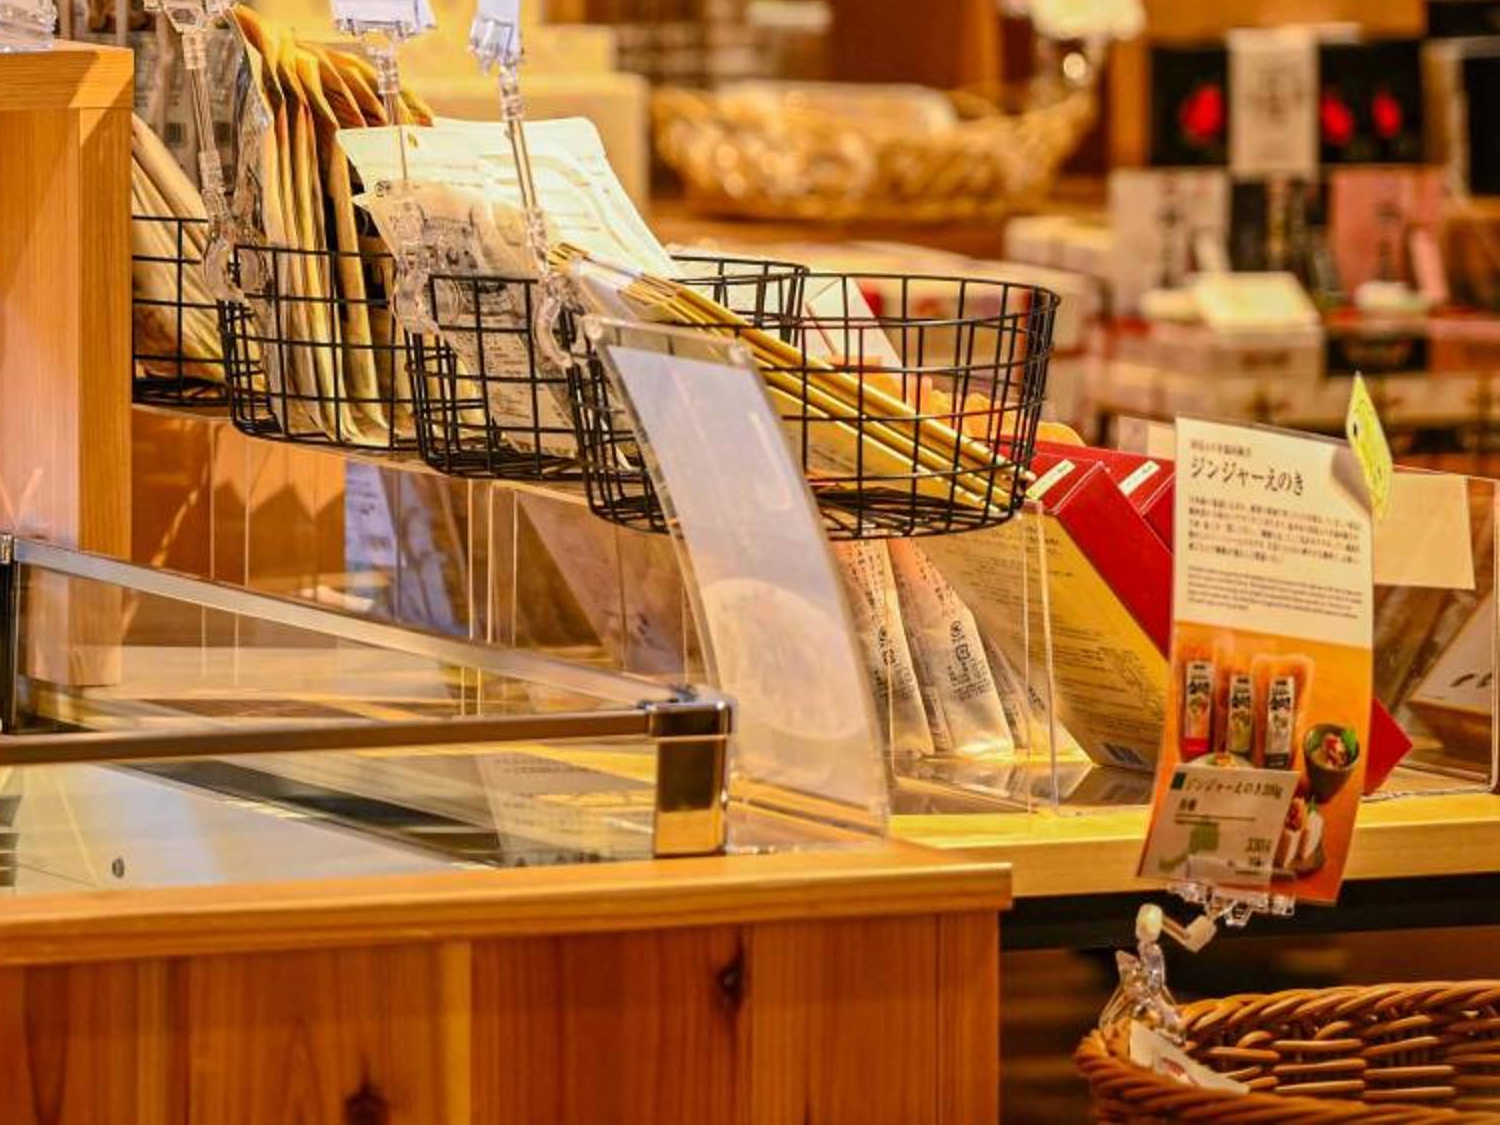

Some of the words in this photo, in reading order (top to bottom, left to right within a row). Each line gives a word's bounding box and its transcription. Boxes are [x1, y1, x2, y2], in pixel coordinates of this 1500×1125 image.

[1190, 456, 1305, 496] ジンジャーえのき
